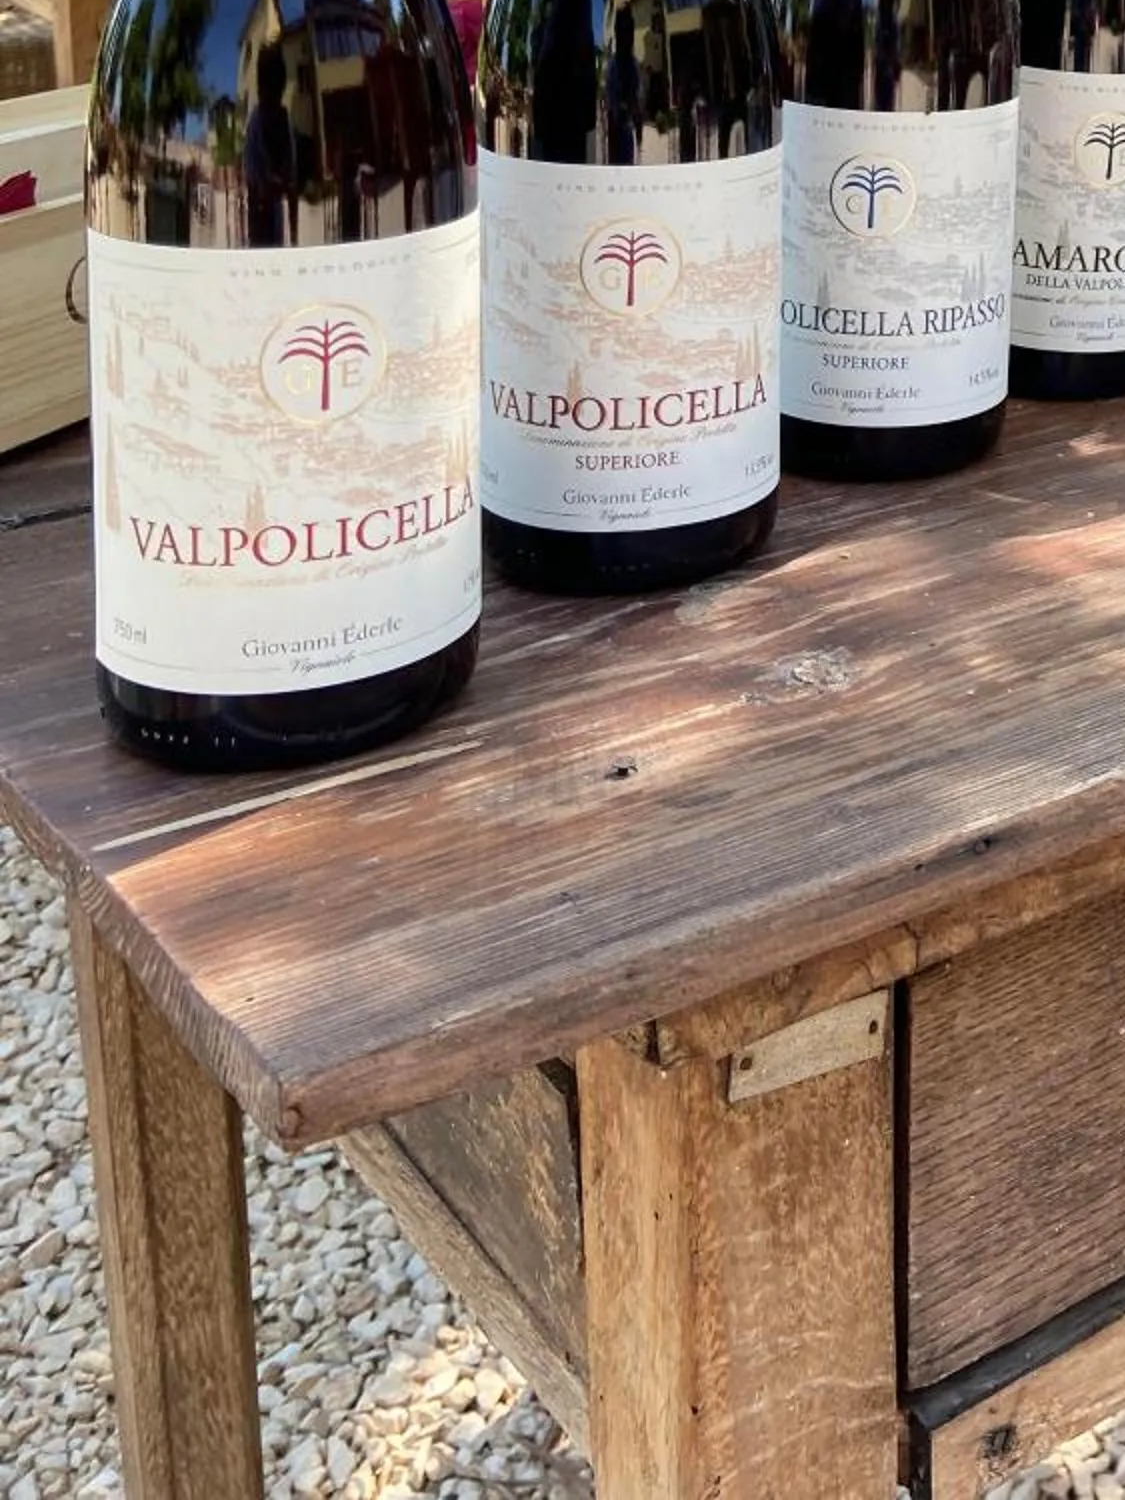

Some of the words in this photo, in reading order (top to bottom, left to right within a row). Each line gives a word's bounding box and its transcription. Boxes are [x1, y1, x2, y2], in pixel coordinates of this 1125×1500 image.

[1026, 273, 1071, 290] DELLA
[922, 293, 1006, 335] RIPASSO
[822, 353, 911, 371] SUPERIORE
[489, 373, 767, 432] VALPOLICELLA
[575, 451, 681, 471] SUPERIORE
[562, 488, 637, 506] Giovanni
[129, 475, 475, 568] VALPOLICELLA
[241, 635, 337, 658] Giovanni
